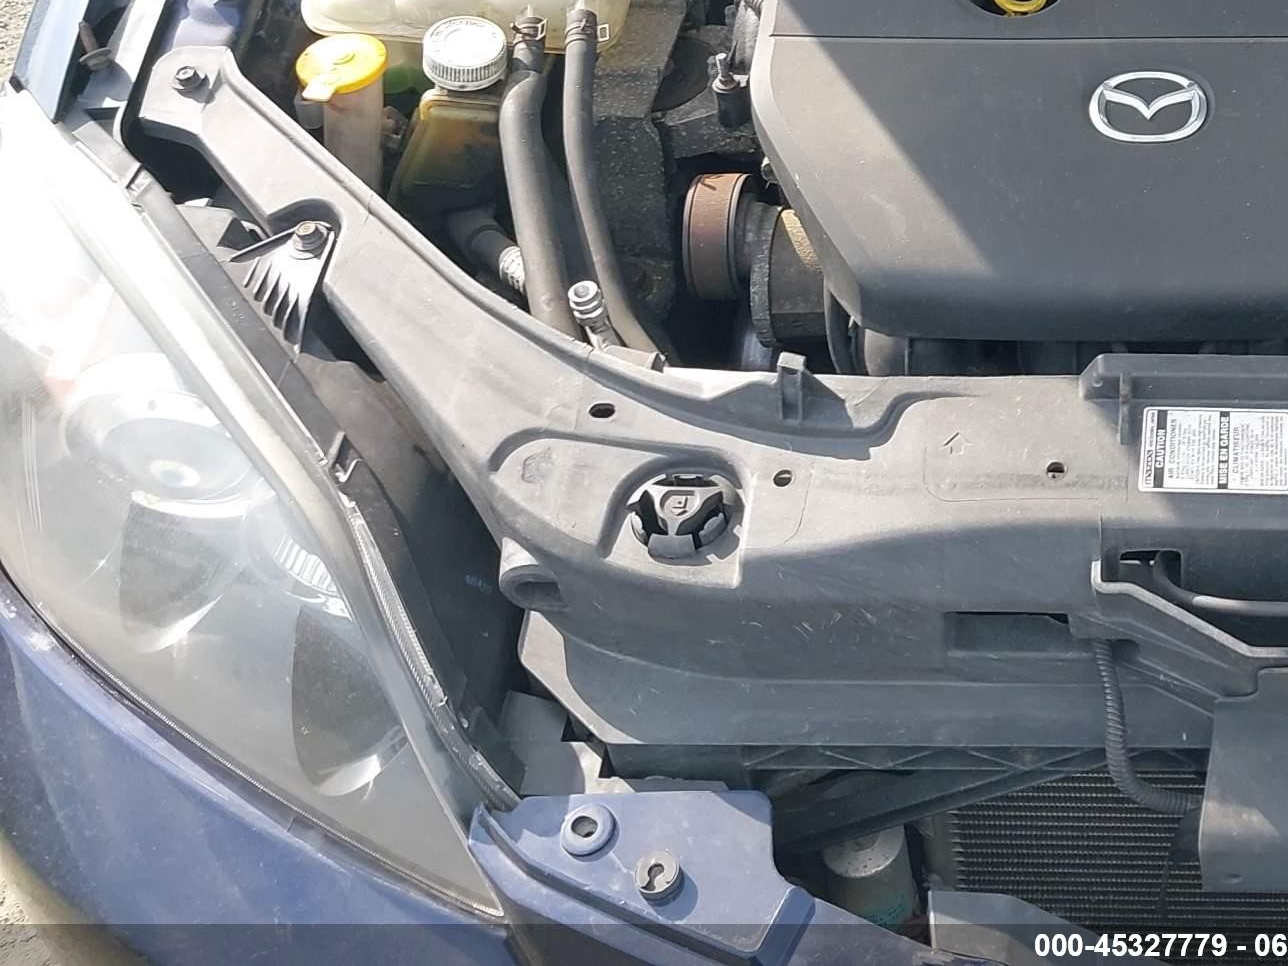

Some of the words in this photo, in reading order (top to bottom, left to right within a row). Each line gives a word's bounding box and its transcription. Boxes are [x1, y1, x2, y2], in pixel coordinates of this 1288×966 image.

[1220, 416, 1230, 447] GARDE
[1155, 429, 1166, 468] CAUTION
[1219, 448, 1228, 461] EN
[1218, 462, 1228, 484] MISE
